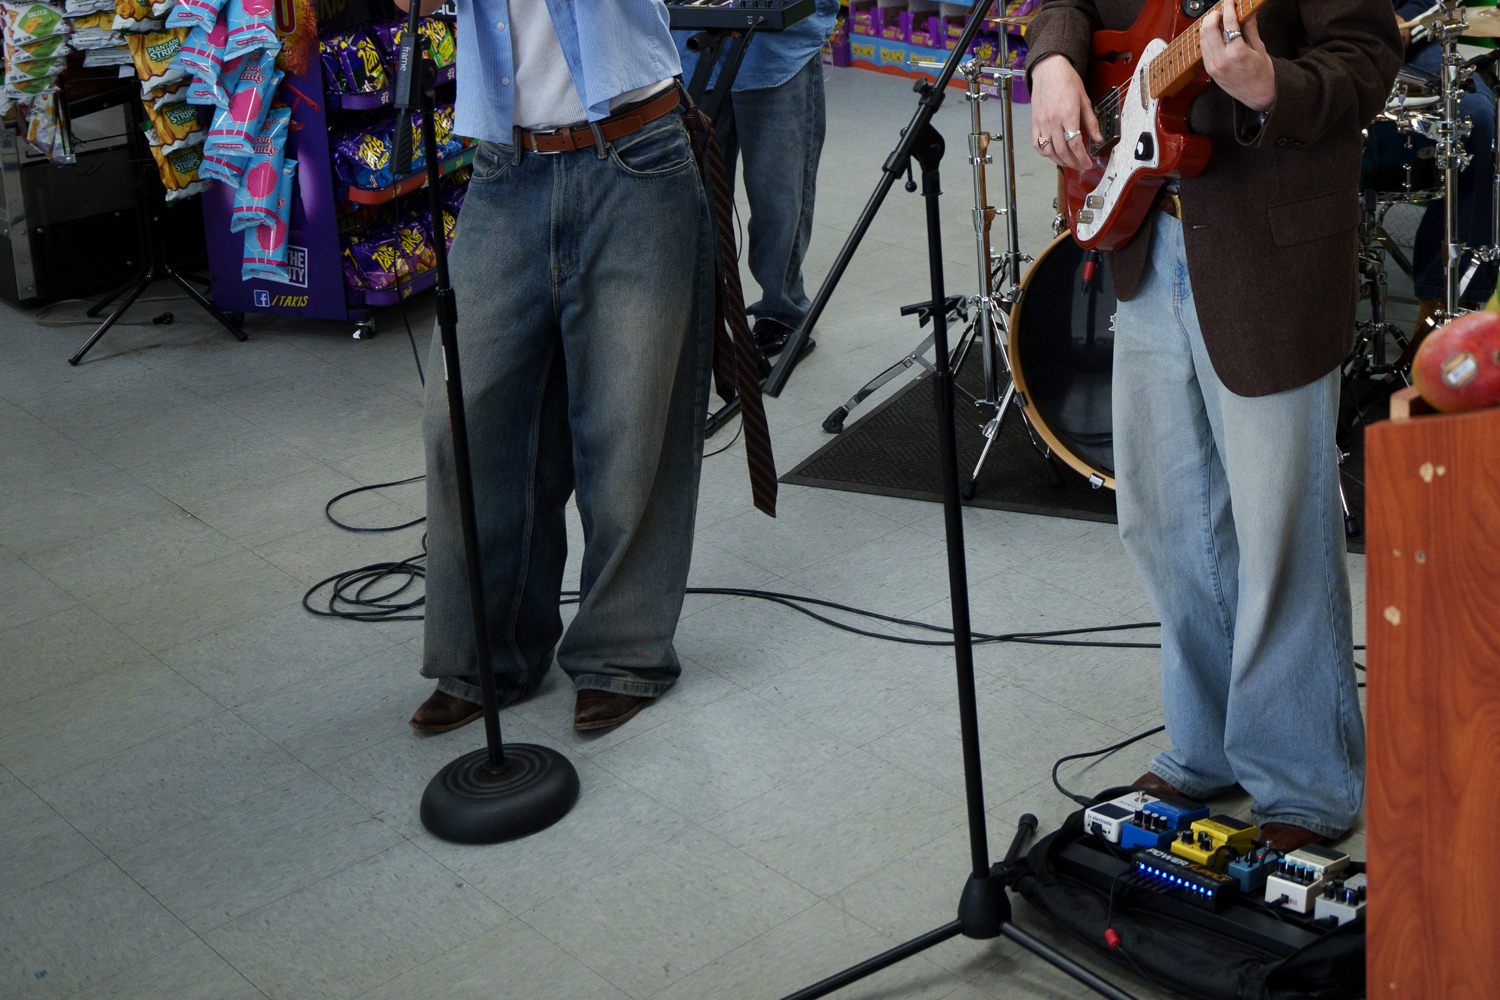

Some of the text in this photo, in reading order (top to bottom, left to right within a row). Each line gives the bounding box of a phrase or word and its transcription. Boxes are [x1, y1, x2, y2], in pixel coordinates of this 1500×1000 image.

[27, 9, 48, 18] SALTED
[148, 38, 180, 53] PLANTAIN
[150, 43, 181, 60] STRIPS
[240, 72, 266, 85] andy
[170, 109, 198, 124] STRIPS
[254, 144, 279, 157] andy
[175, 157, 200, 172] STRIPS
[1146, 848, 1189, 867] POWER
